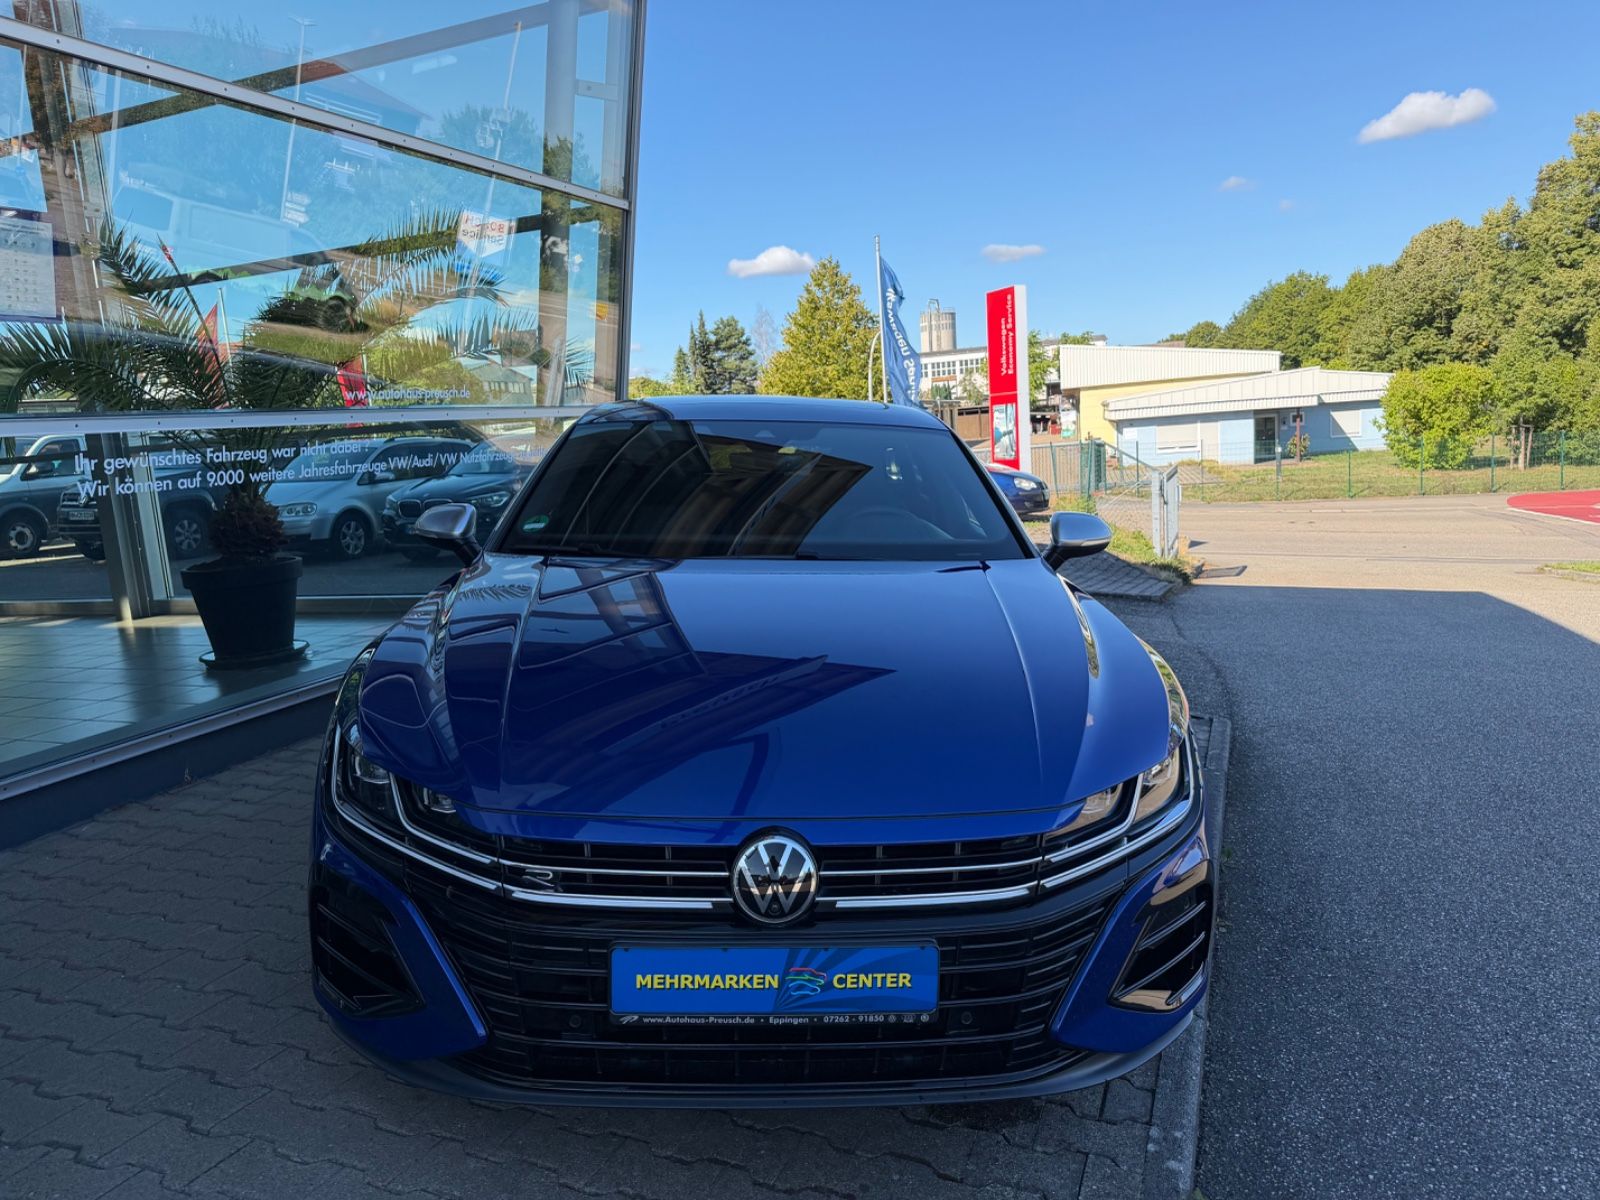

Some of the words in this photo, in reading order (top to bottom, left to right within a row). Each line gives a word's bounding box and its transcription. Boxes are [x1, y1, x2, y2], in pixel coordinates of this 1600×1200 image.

[1000, 317, 1008, 376] Volkswagen
[1007, 331, 1015, 375] Economy
[345, 384, 471, 401] www.autohaus-preusch.de
[74, 452, 98, 474] Ihr
[103, 448, 201, 475] gewünschtes
[206, 444, 268, 464] Fahrzeug
[271, 447, 296, 459] war
[300, 439, 326, 457] nicht
[329, 439, 362, 455] dabei
[76, 480, 109, 499] Wir
[115, 475, 172, 496] können
[177, 471, 202, 490] auf
[206, 469, 245, 488] 9.000
[249, 467, 296, 483] weitere
[298, 459, 388, 479] Jahresfahrzeuge
[635, 973, 780, 990] MEHRMARKEN
[832, 972, 913, 989] CENTER
[642, 1015, 755, 1025] www.Autohaus-Preusch.de
[769, 1016, 809, 1025] Eppingen
[823, 1015, 850, 1023] 07262
[858, 1014, 884, 1023] 91850
